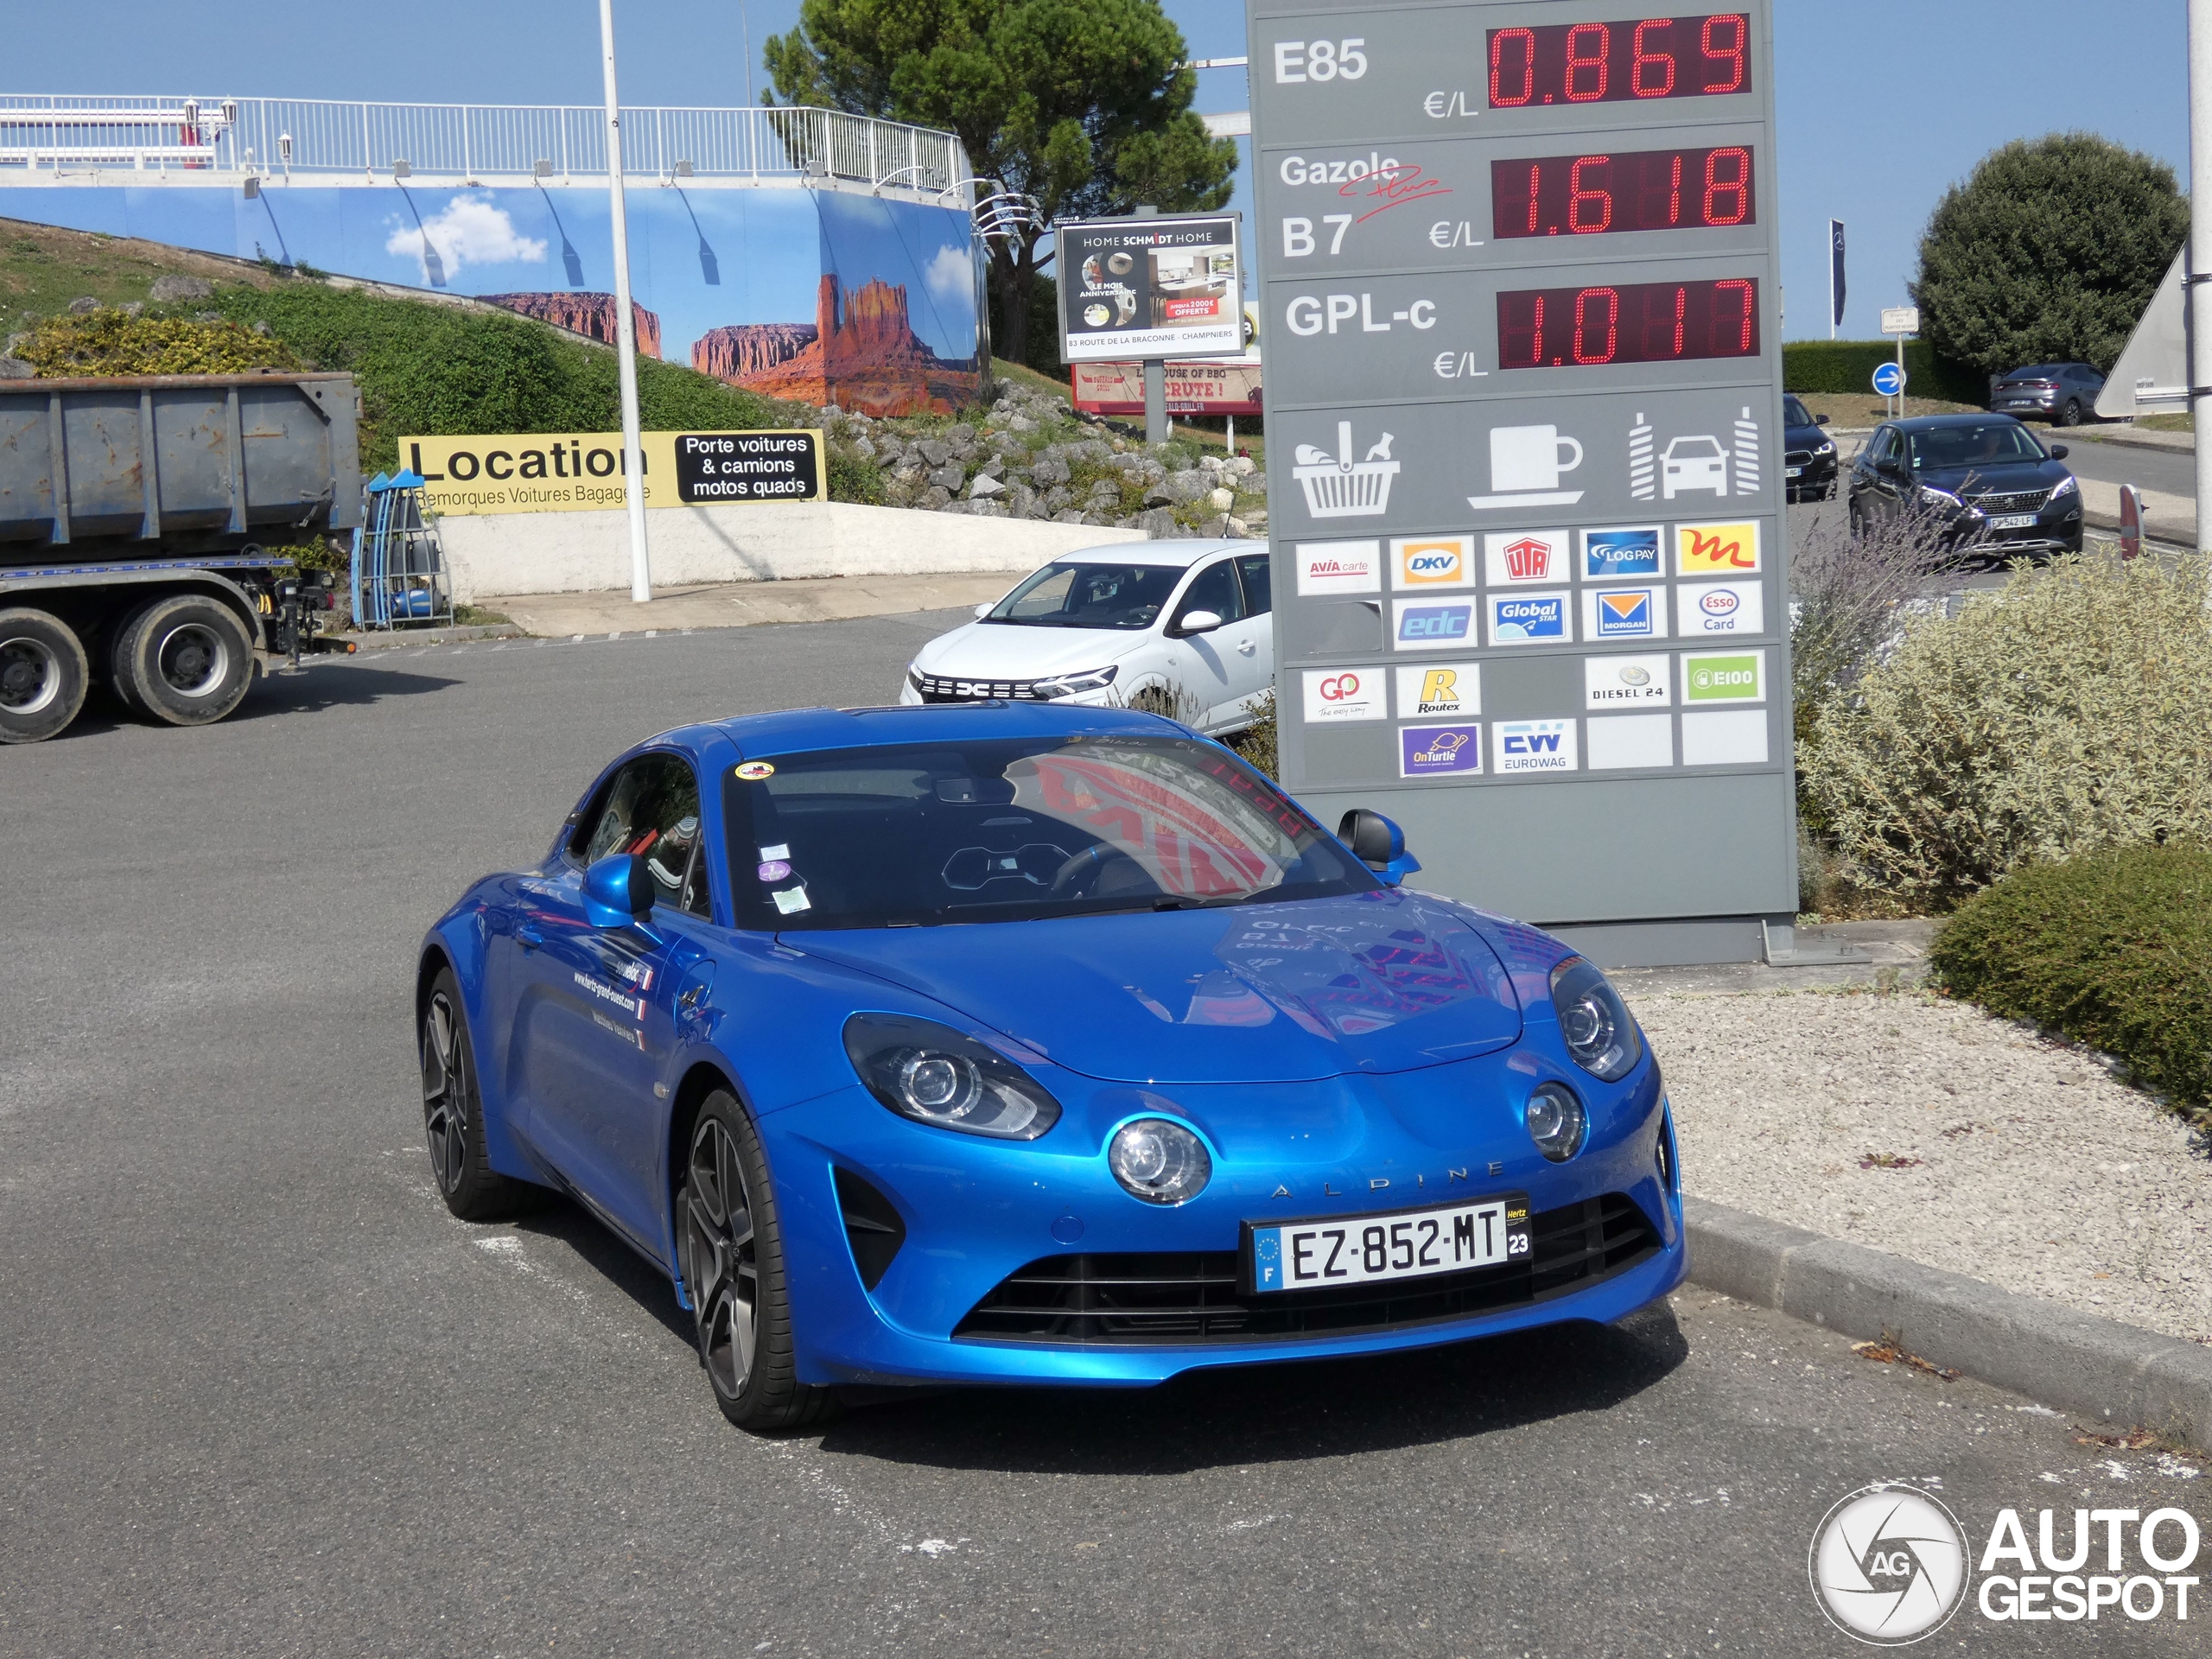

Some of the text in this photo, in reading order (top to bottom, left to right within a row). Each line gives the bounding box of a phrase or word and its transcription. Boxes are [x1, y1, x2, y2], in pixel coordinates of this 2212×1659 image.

[1274, 38, 1369, 84] E85
[1491, 14, 1745, 107] 0.869
[1422, 90, 1479, 118] €/L
[1280, 152, 1401, 186] Gazole
[1528, 147, 1748, 235] 1.618
[1084, 237, 1120, 248] HOME
[1176, 232, 1212, 244] HOME
[1428, 221, 1484, 249] €/L
[1103, 282, 1123, 290] MOIS
[1286, 294, 1437, 336] GPL-c
[1533, 279, 1754, 366] 1.017
[1080, 337, 1105, 347] ROUTE
[1107, 336, 1118, 346] DE
[1120, 335, 1130, 344] LA
[1132, 334, 1176, 344] BRACONNE
[1182, 330, 1233, 340] CHAMPNIERS
[1191, 368, 1204, 378] OF
[1209, 369, 1227, 378] BBQ
[1433, 351, 1490, 378] €/L
[686, 436, 808, 454] Porte voitures
[702, 457, 795, 475] & camions
[508, 486, 570, 504] Voitures
[694, 478, 806, 498] motos quads
[1411, 556, 1454, 570] DKV
[1507, 538, 1549, 576] UTA
[1342, 562, 1369, 571] carte
[1502, 602, 1557, 618] Global
[1706, 596, 1734, 608] Esso
[1403, 610, 1466, 637] edc
[1605, 620, 1646, 630] MORGAN
[1703, 617, 1735, 630] Card
[1713, 670, 1753, 685] E100
[1319, 673, 1360, 701] GO
[1592, 687, 1664, 700] DIESEL 24
[1318, 708, 1332, 716] The
[1333, 708, 1348, 716] easy
[1418, 703, 1460, 714] Routex
[1414, 750, 1456, 762] OnTurtle
[1504, 757, 1567, 769] EUROWAG
[1271, 1161, 1503, 1199] ALPINE
[1507, 1208, 1527, 1220] Hertz
[1292, 1210, 1498, 1281] EZ-852-MT
[1509, 1233, 1529, 1255] 23
[1264, 1268, 1274, 1282] F
